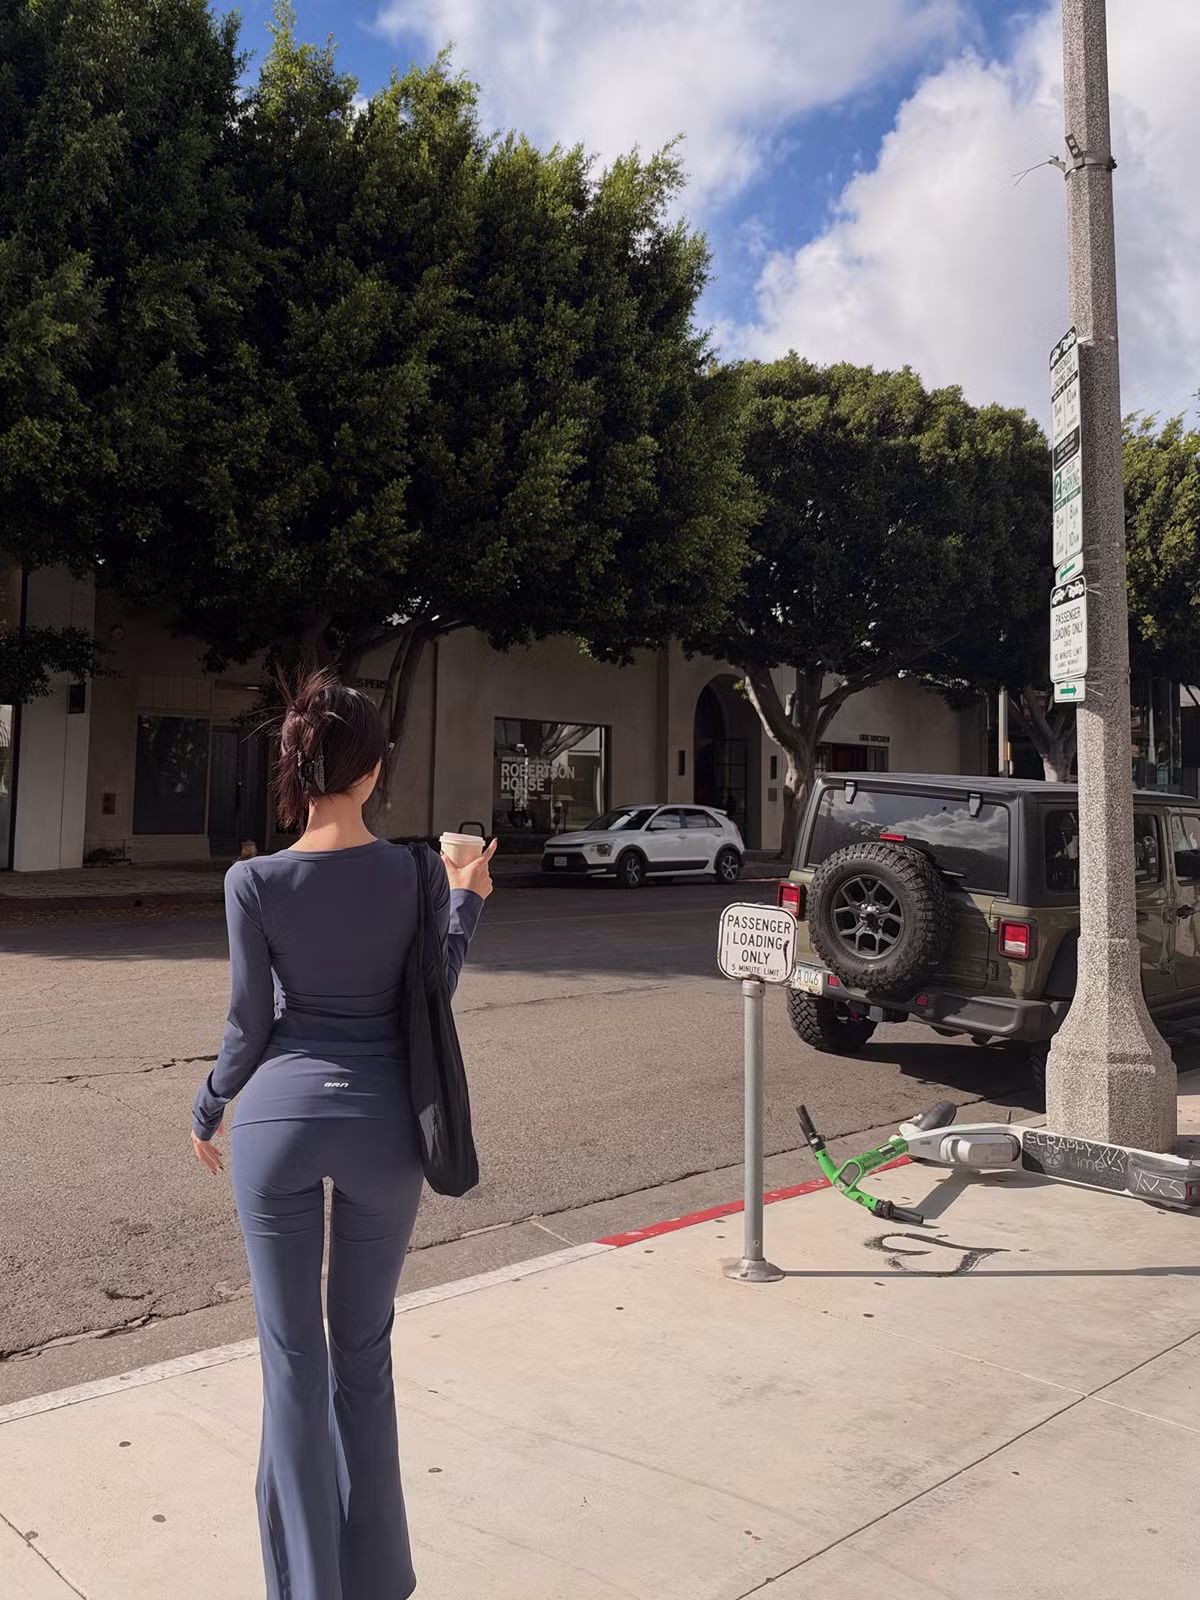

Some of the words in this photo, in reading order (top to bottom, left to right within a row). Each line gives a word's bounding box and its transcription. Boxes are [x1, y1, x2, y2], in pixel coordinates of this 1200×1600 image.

[1055, 475, 1061, 501] 2
[1062, 468, 1080, 491] PARKING
[1055, 606, 1080, 626] PASSENGER
[1052, 624, 1071, 642] LOADING
[1072, 619, 1084, 636] ONLY
[1059, 649, 1072, 660] MINUTE
[1073, 646, 1082, 657] LIMIT
[501, 763, 575, 779] ROBERTSON
[501, 777, 545, 791] HOUSE
[727, 914, 791, 934] PASSENGER
[733, 932, 783, 950] LOADING
[741, 949, 771, 965] ONLY
[738, 965, 761, 974] MINUTE
[763, 967, 780, 977] LIMIT
